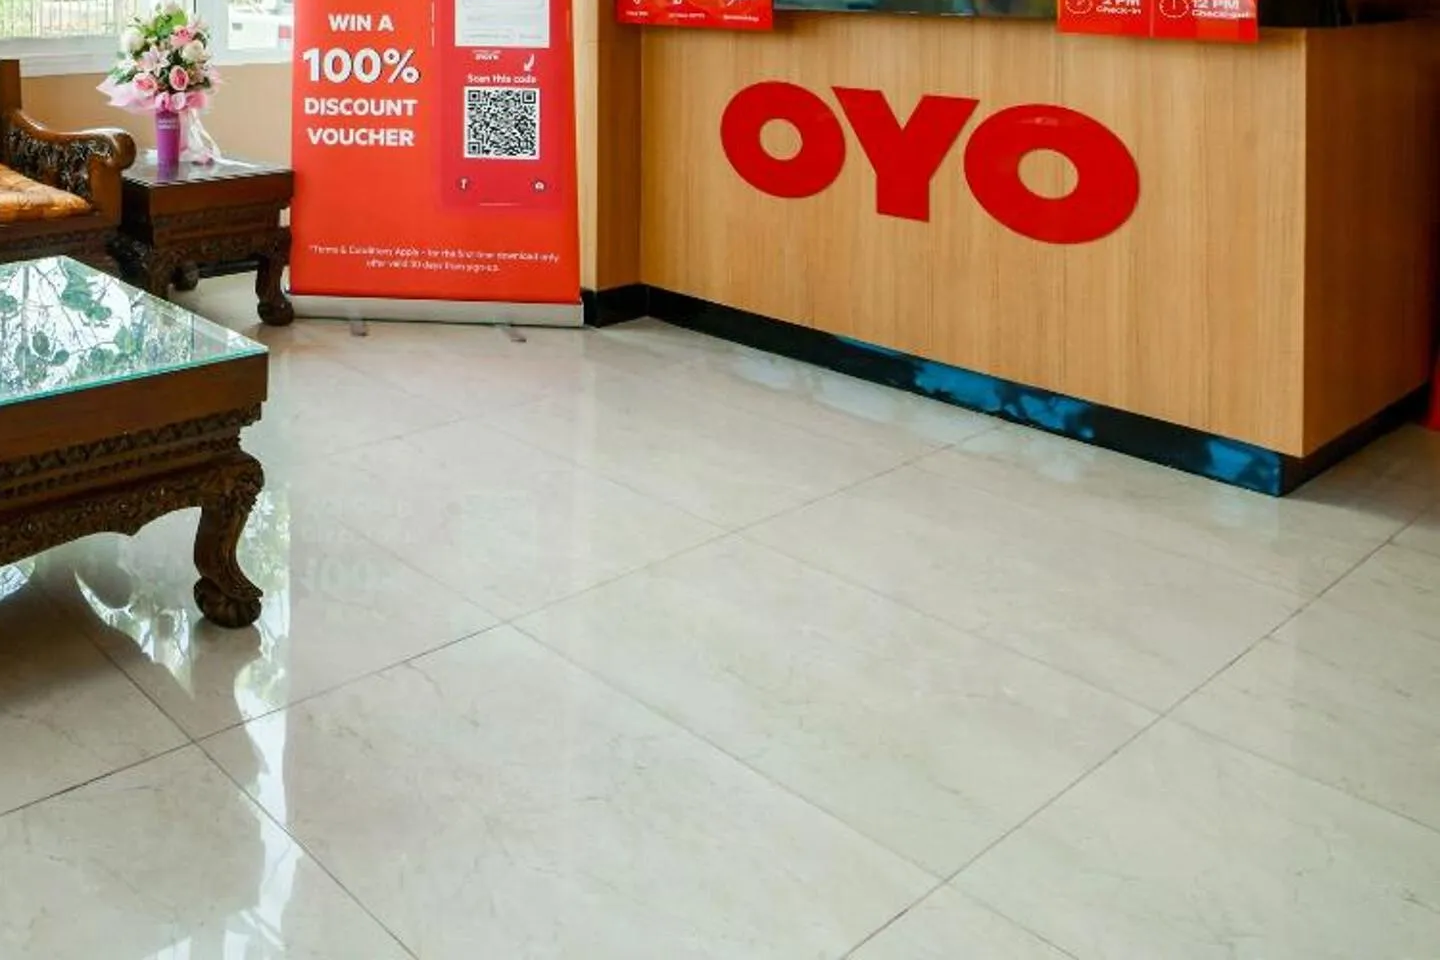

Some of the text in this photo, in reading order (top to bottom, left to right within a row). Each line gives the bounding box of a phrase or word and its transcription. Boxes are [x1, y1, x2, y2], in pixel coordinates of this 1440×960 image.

[1096, 5, 1141, 15] Check-in
[328, 13, 395, 32] WIN A
[302, 47, 421, 84] 100%
[467, 73, 537, 84] Scan this code
[304, 97, 419, 117] DISCOUNT
[307, 127, 416, 147] VOUCHER
[720, 80, 1141, 245] OYO
